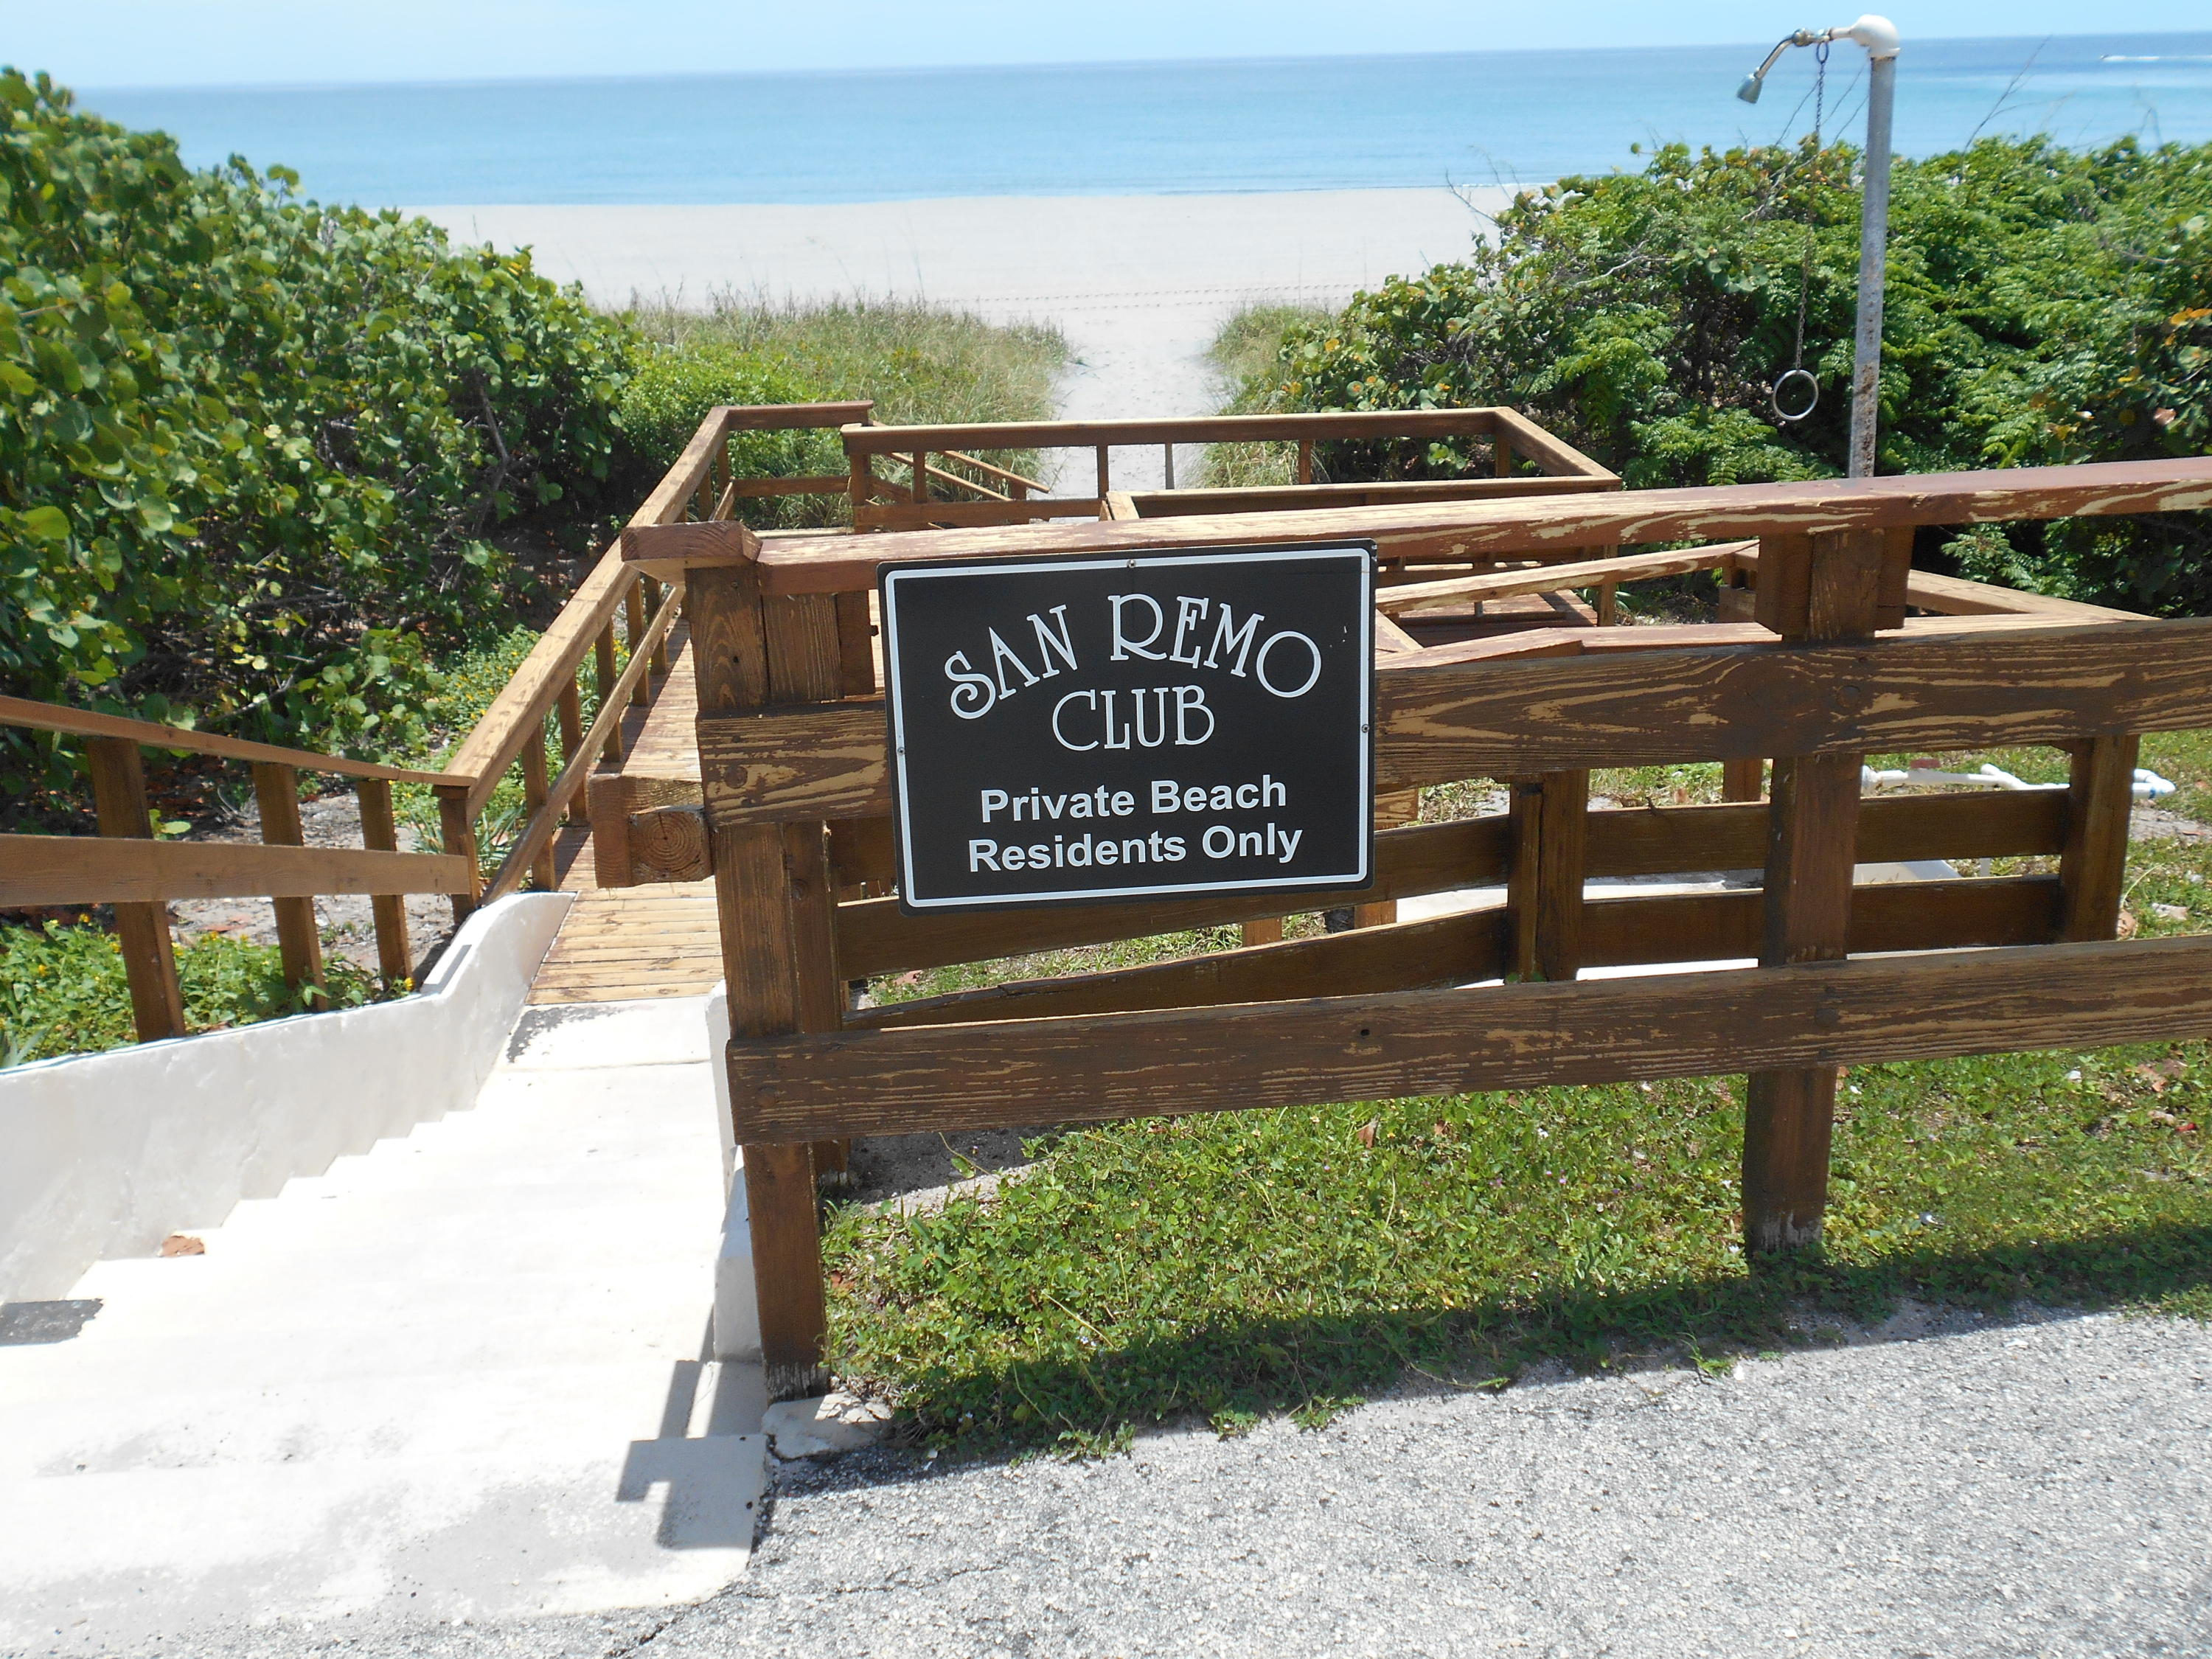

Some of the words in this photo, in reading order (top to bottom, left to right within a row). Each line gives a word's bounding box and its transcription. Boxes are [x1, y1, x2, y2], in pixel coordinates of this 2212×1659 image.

[944, 604, 1078, 720] SAN
[1107, 594, 1322, 698] REMO
[1051, 684, 1214, 751] CLUB
[981, 785, 1135, 823] Private
[1151, 774, 1287, 814] Beach
[968, 830, 1186, 872] Residents
[1202, 822, 1303, 863] Only
